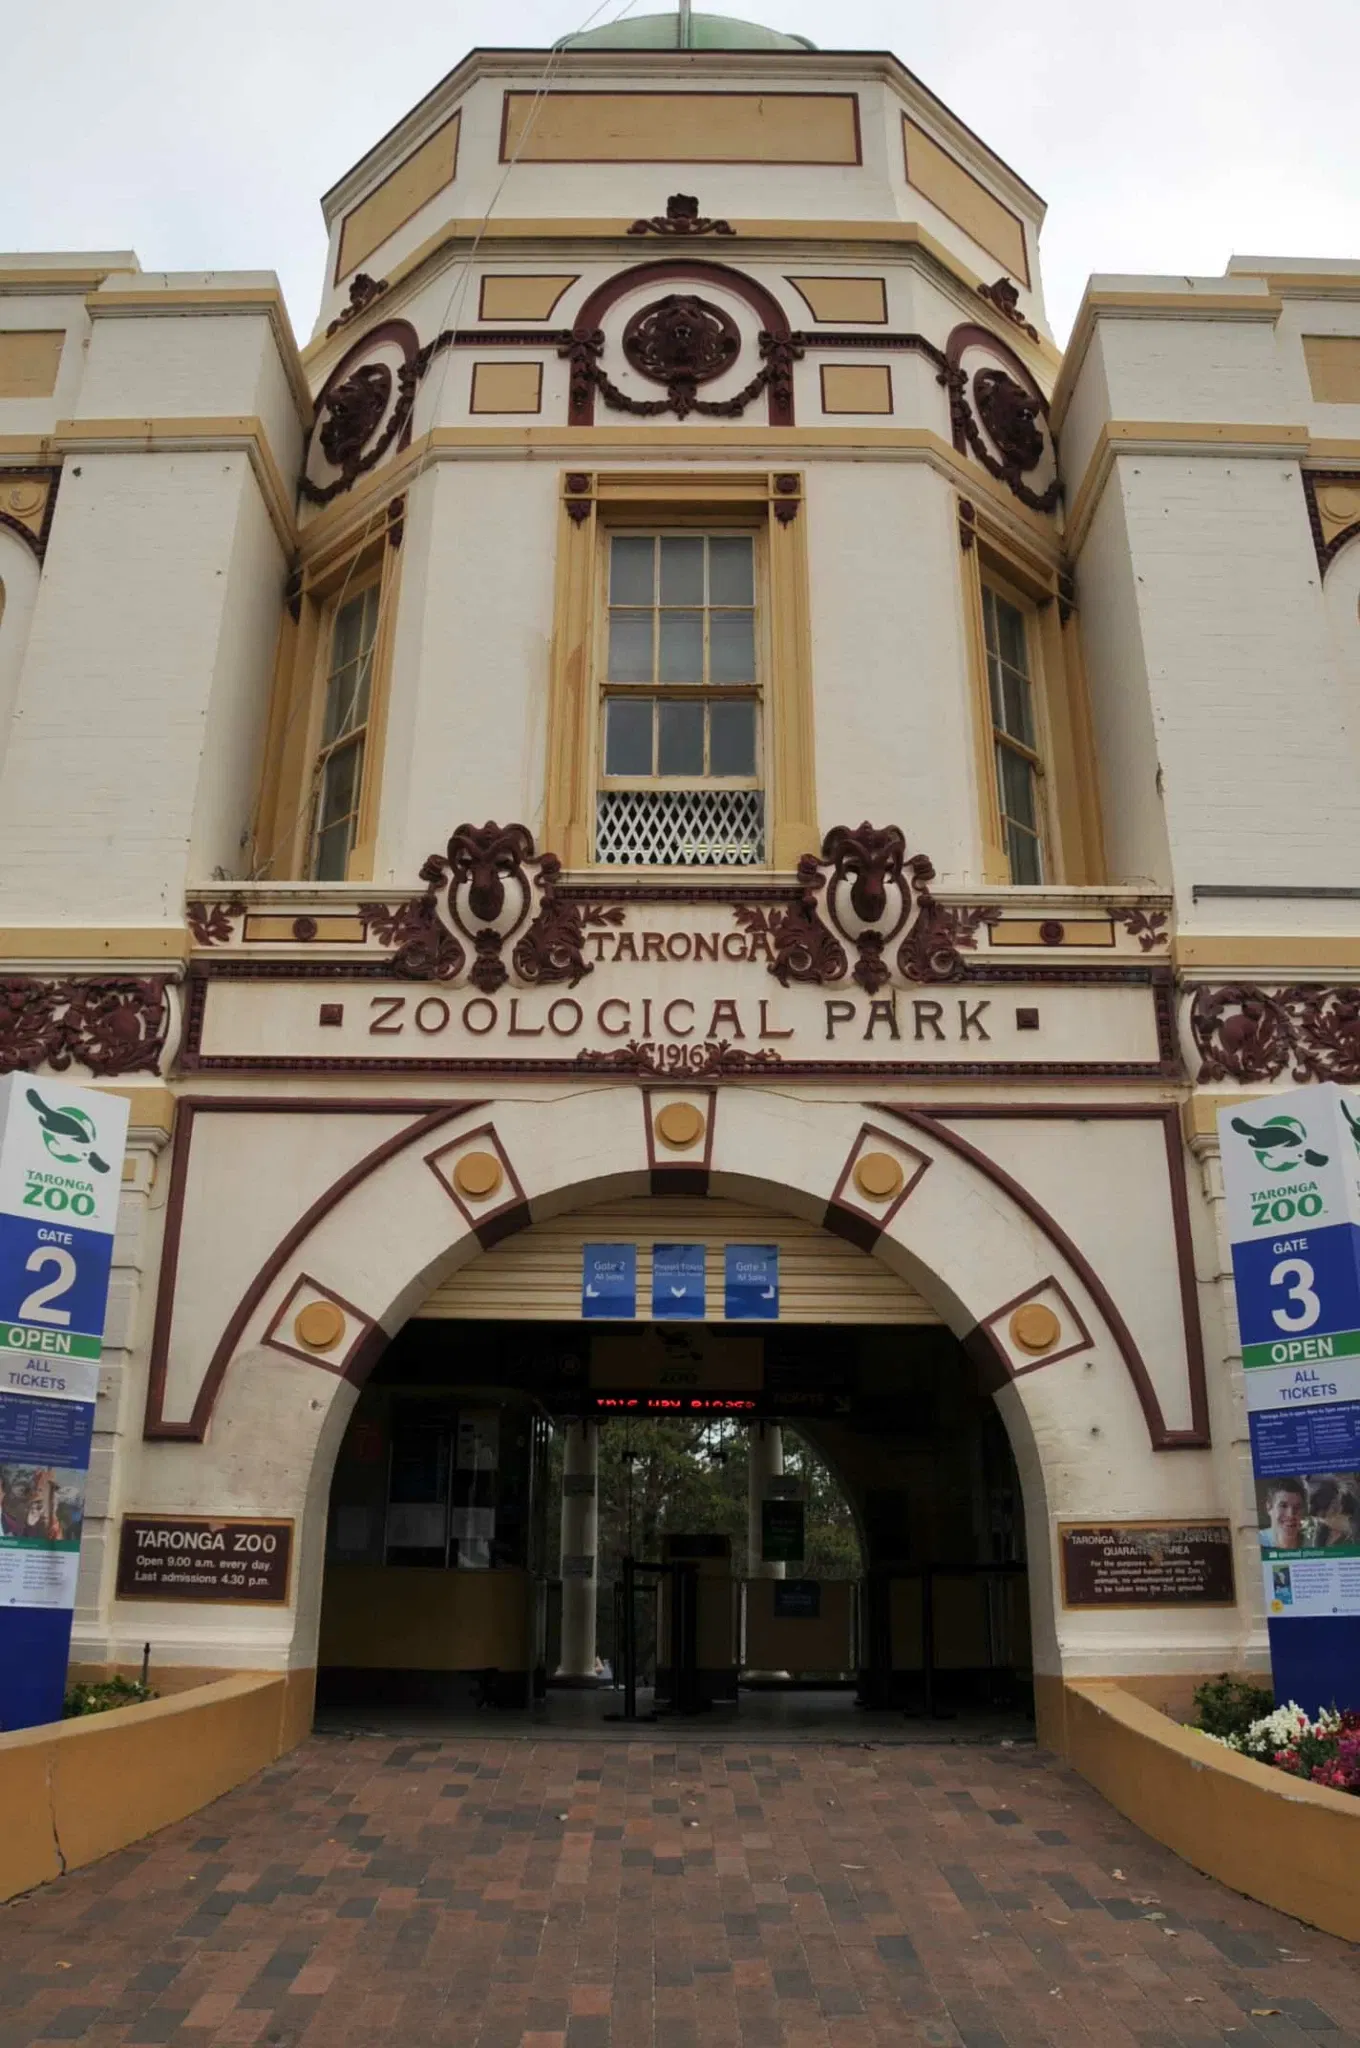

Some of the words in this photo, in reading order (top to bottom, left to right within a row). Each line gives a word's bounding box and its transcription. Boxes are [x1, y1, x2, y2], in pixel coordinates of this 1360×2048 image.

[588, 932, 774, 962] TARONGA
[369, 996, 794, 1038] ZOOLOGICAL
[825, 999, 992, 1041] PARK
[656, 1043, 704, 1067] 1916
[26, 1169, 94, 1193] TARONGA
[1250, 1180, 1318, 1203] TARONGA
[22, 1182, 96, 1217] ZOO
[1251, 1192, 1324, 1227] ZOO
[36, 1227, 74, 1245] GATE
[1272, 1237, 1310, 1255] GATE
[594, 1260, 616, 1271] Gate
[619, 1261, 626, 1271] 2
[736, 1261, 759, 1272] Gate
[17, 1245, 78, 1326] 2
[1269, 1257, 1322, 1333] 3
[7, 1327, 72, 1353] OPEN
[1270, 1337, 1334, 1363] OPEN
[25, 1359, 52, 1373] ALL
[1294, 1369, 1320, 1383] ALL
[8, 1372, 66, 1391] TICKETS
[1279, 1383, 1338, 1401] TICKETS
[135, 1529, 226, 1551] TARONGA
[233, 1534, 277, 1553] ZOO
[1071, 1535, 1115, 1545] TARONGA
[136, 1555, 164, 1567] Open
[167, 1556, 191, 1568] 9.00
[194, 1559, 215, 1568] a.m.
[219, 1560, 247, 1571] every
[251, 1559, 272, 1572] day.
[134, 1571, 157, 1582] Last
[161, 1573, 217, 1584] admissions
[220, 1574, 245, 1585] 4.30
[248, 1576, 270, 1587] p.m.
